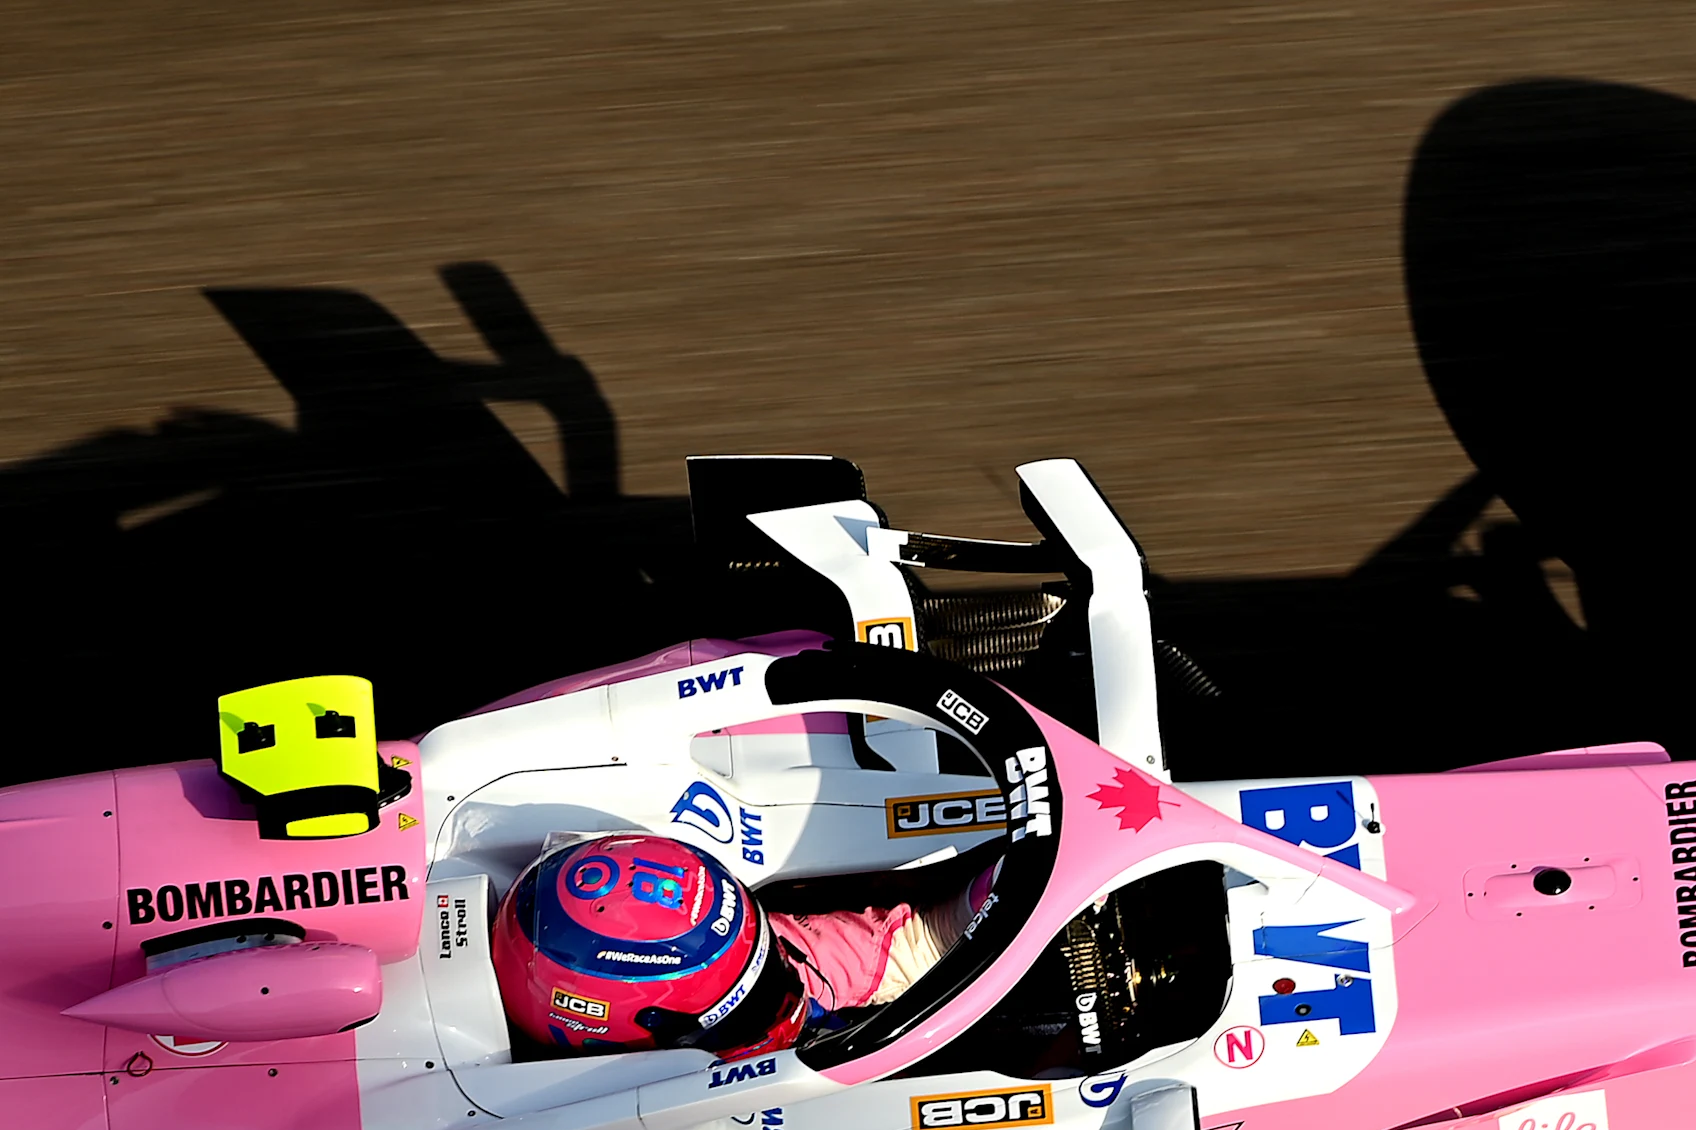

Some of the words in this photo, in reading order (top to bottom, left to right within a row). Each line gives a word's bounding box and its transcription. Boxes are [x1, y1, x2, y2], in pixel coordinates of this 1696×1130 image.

[678, 666, 744, 699] BWT
[941, 692, 984, 731] JCB
[739, 807, 764, 865] BWT
[127, 865, 410, 925] BOMBARDIER
[633, 857, 685, 910] 18
[440, 911, 451, 959] Lance
[455, 899, 468, 947] Stroll
[964, 892, 999, 940] telcel
[605, 951, 681, 965] #WeRaceAsOne
[555, 995, 606, 1017] JCB
[718, 985, 746, 1015] BWT
[1078, 1012, 1102, 1054] BWT
[1224, 1032, 1254, 1065] N
[708, 1058, 776, 1089] BWT
[920, 1092, 1042, 1127] JCB
